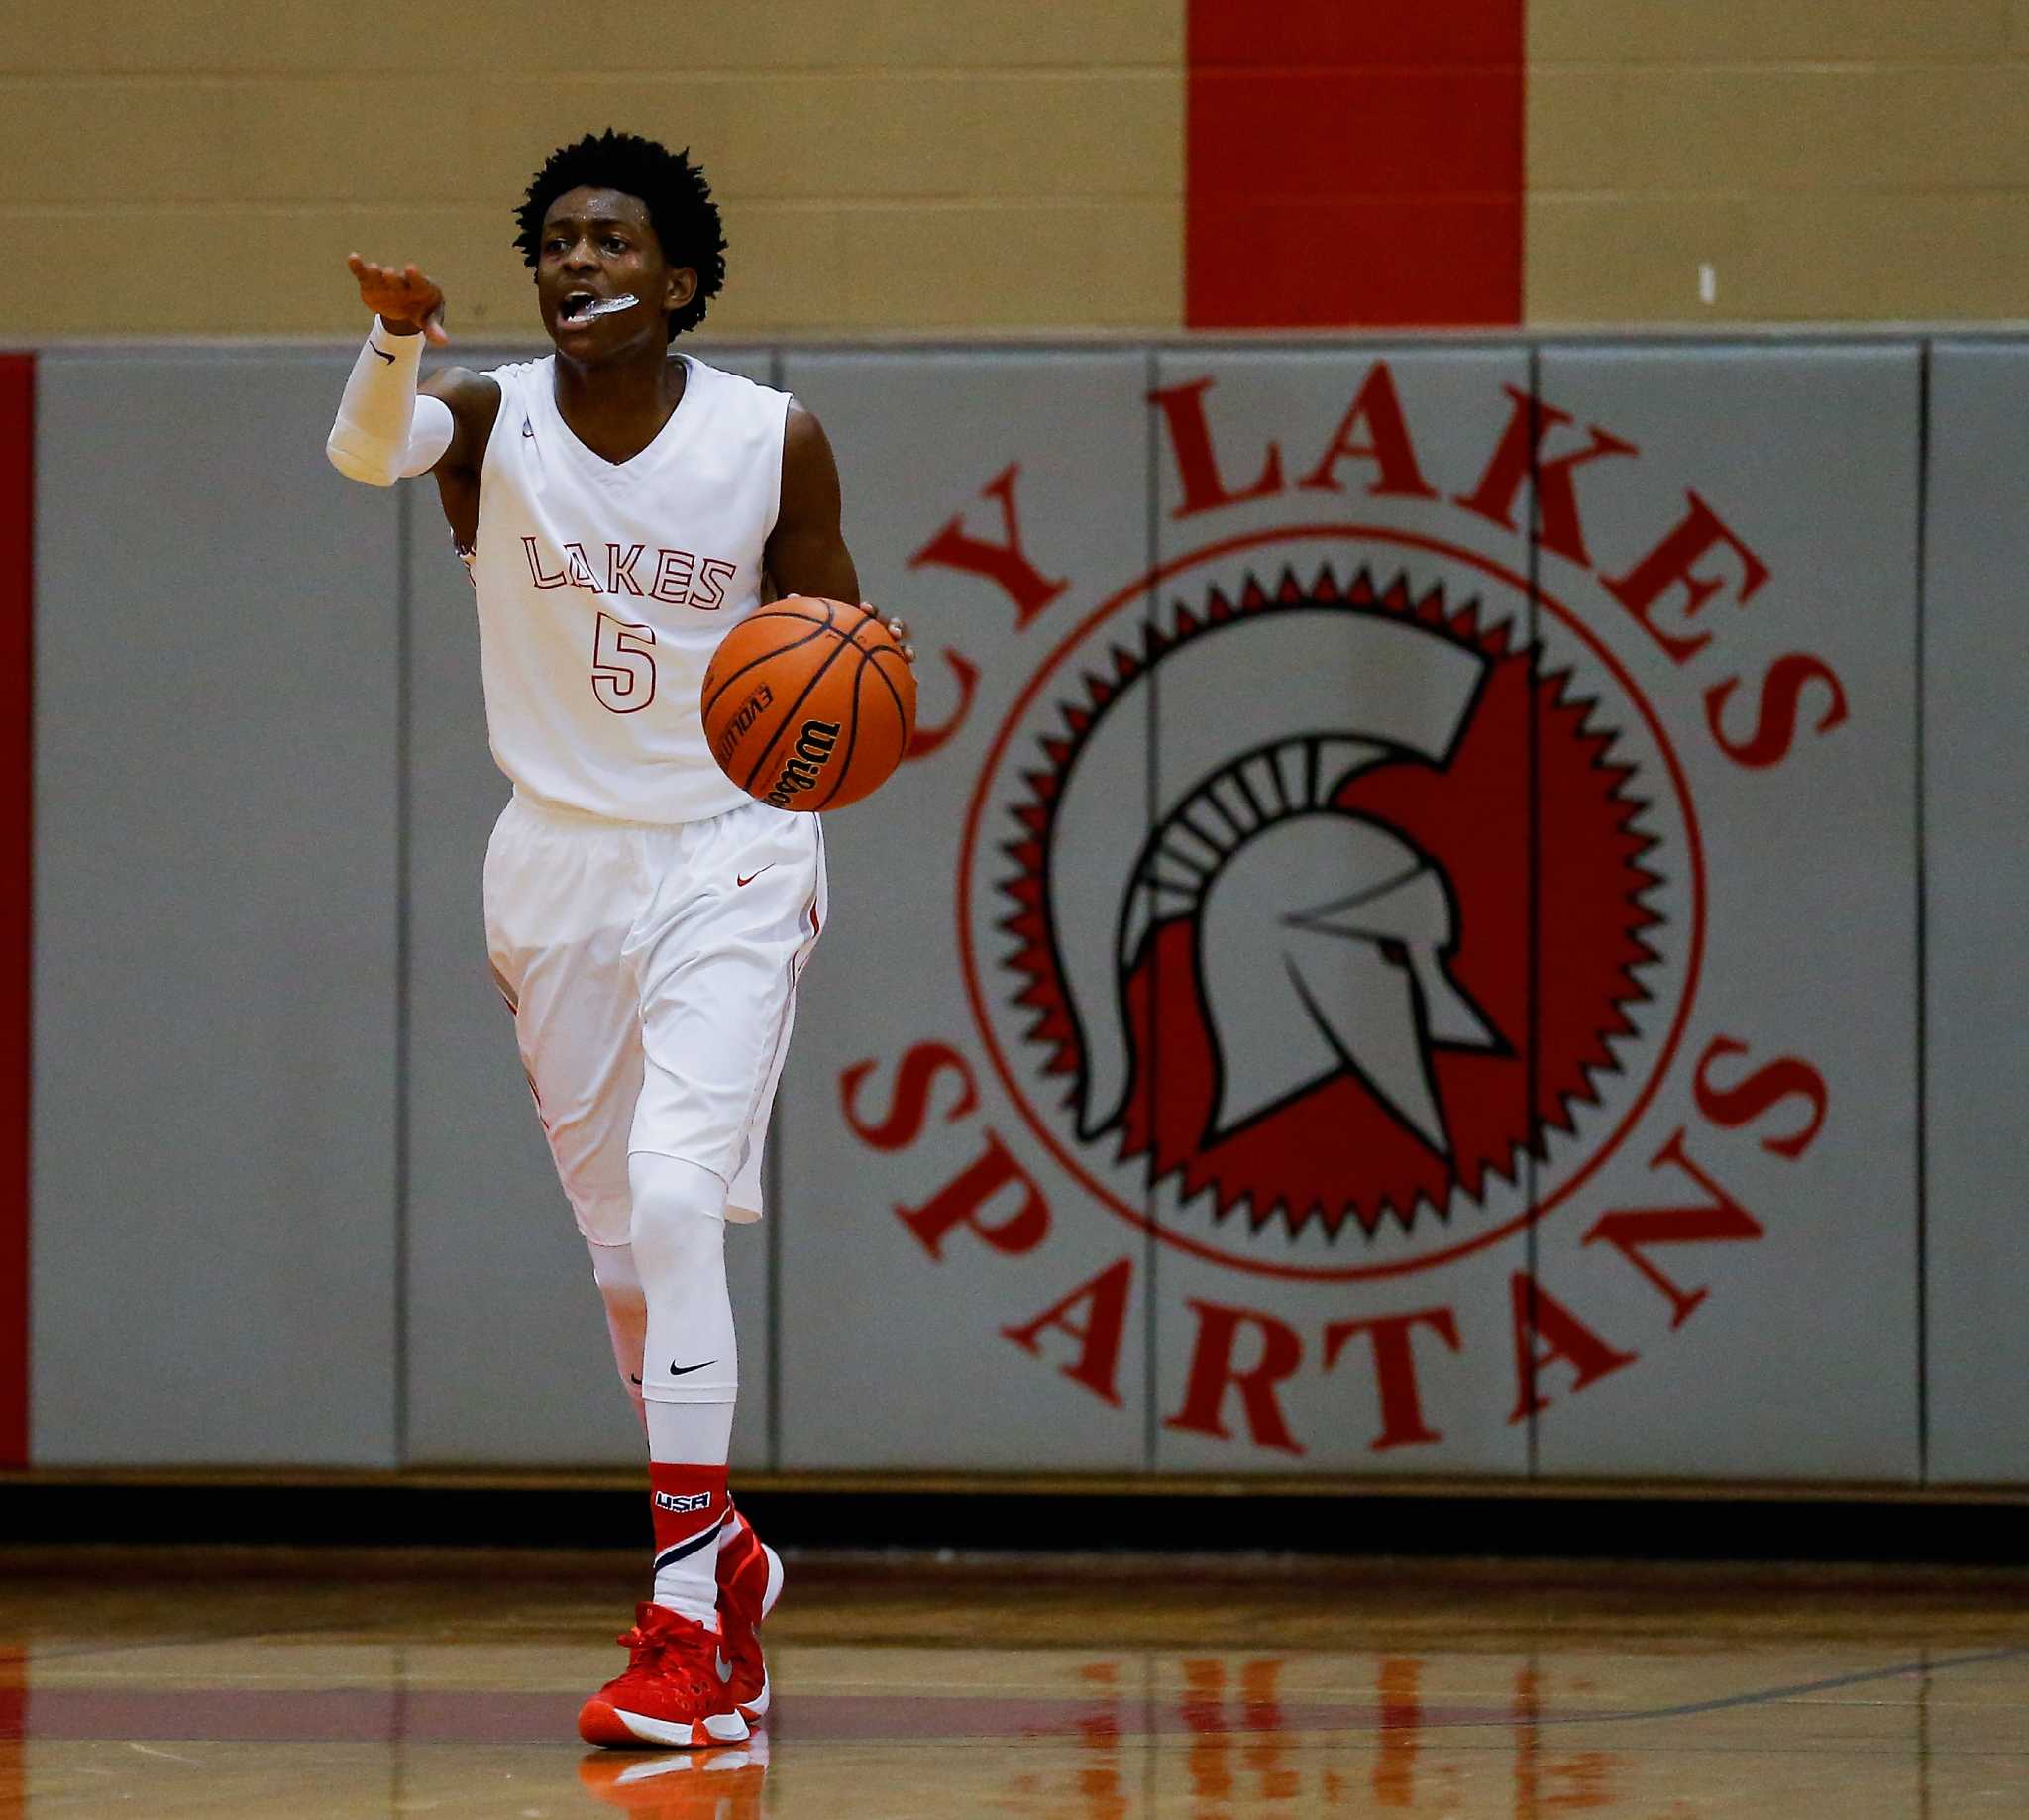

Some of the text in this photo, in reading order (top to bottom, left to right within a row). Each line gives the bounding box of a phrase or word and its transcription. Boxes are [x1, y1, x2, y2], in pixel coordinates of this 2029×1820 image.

[521, 536, 737, 610] LAKES
[1146, 359, 1850, 773] LAKES
[591, 611, 656, 714] 5
[838, 1033, 1829, 1457] SPARTANS
[656, 1491, 710, 1512] USA
